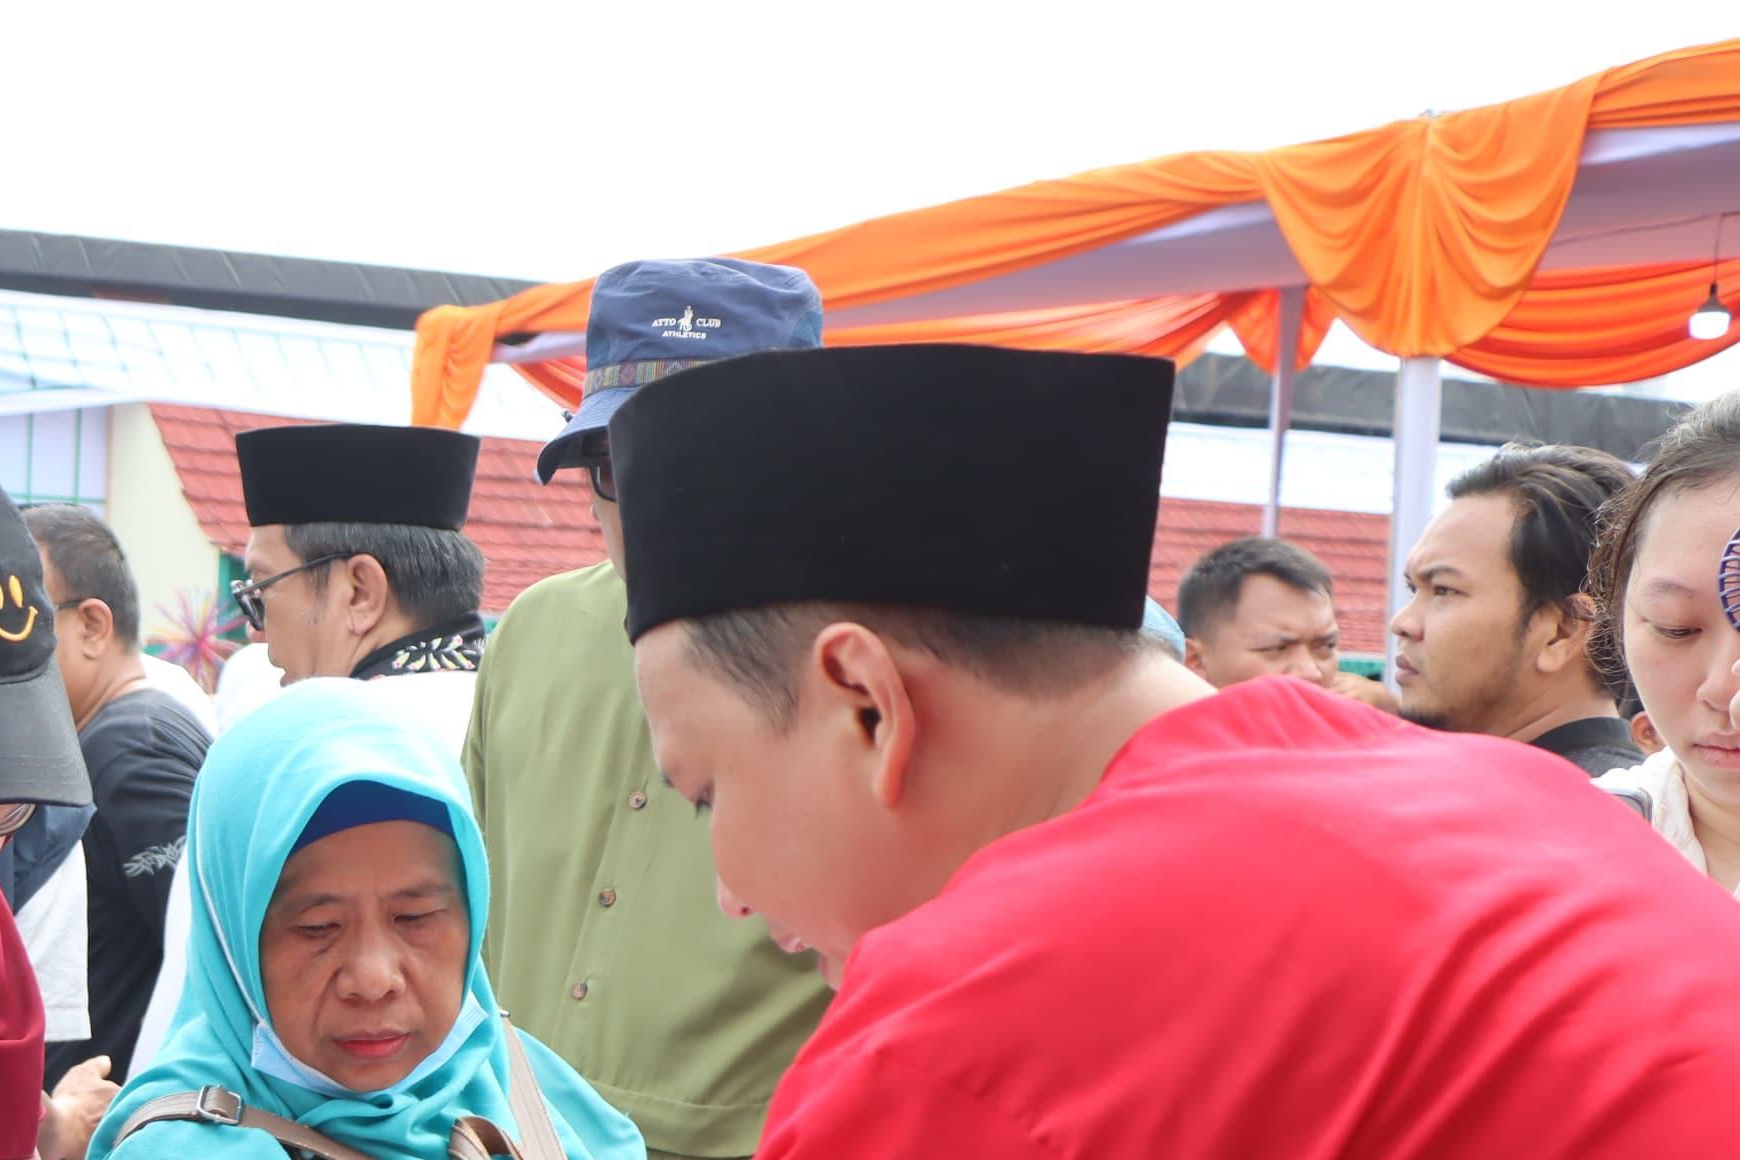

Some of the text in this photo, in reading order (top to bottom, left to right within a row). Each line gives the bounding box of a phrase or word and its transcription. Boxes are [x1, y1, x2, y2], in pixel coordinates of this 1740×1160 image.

[652, 318, 722, 328] ATTO CLUB
[662, 331, 707, 339] ATHLETICS
